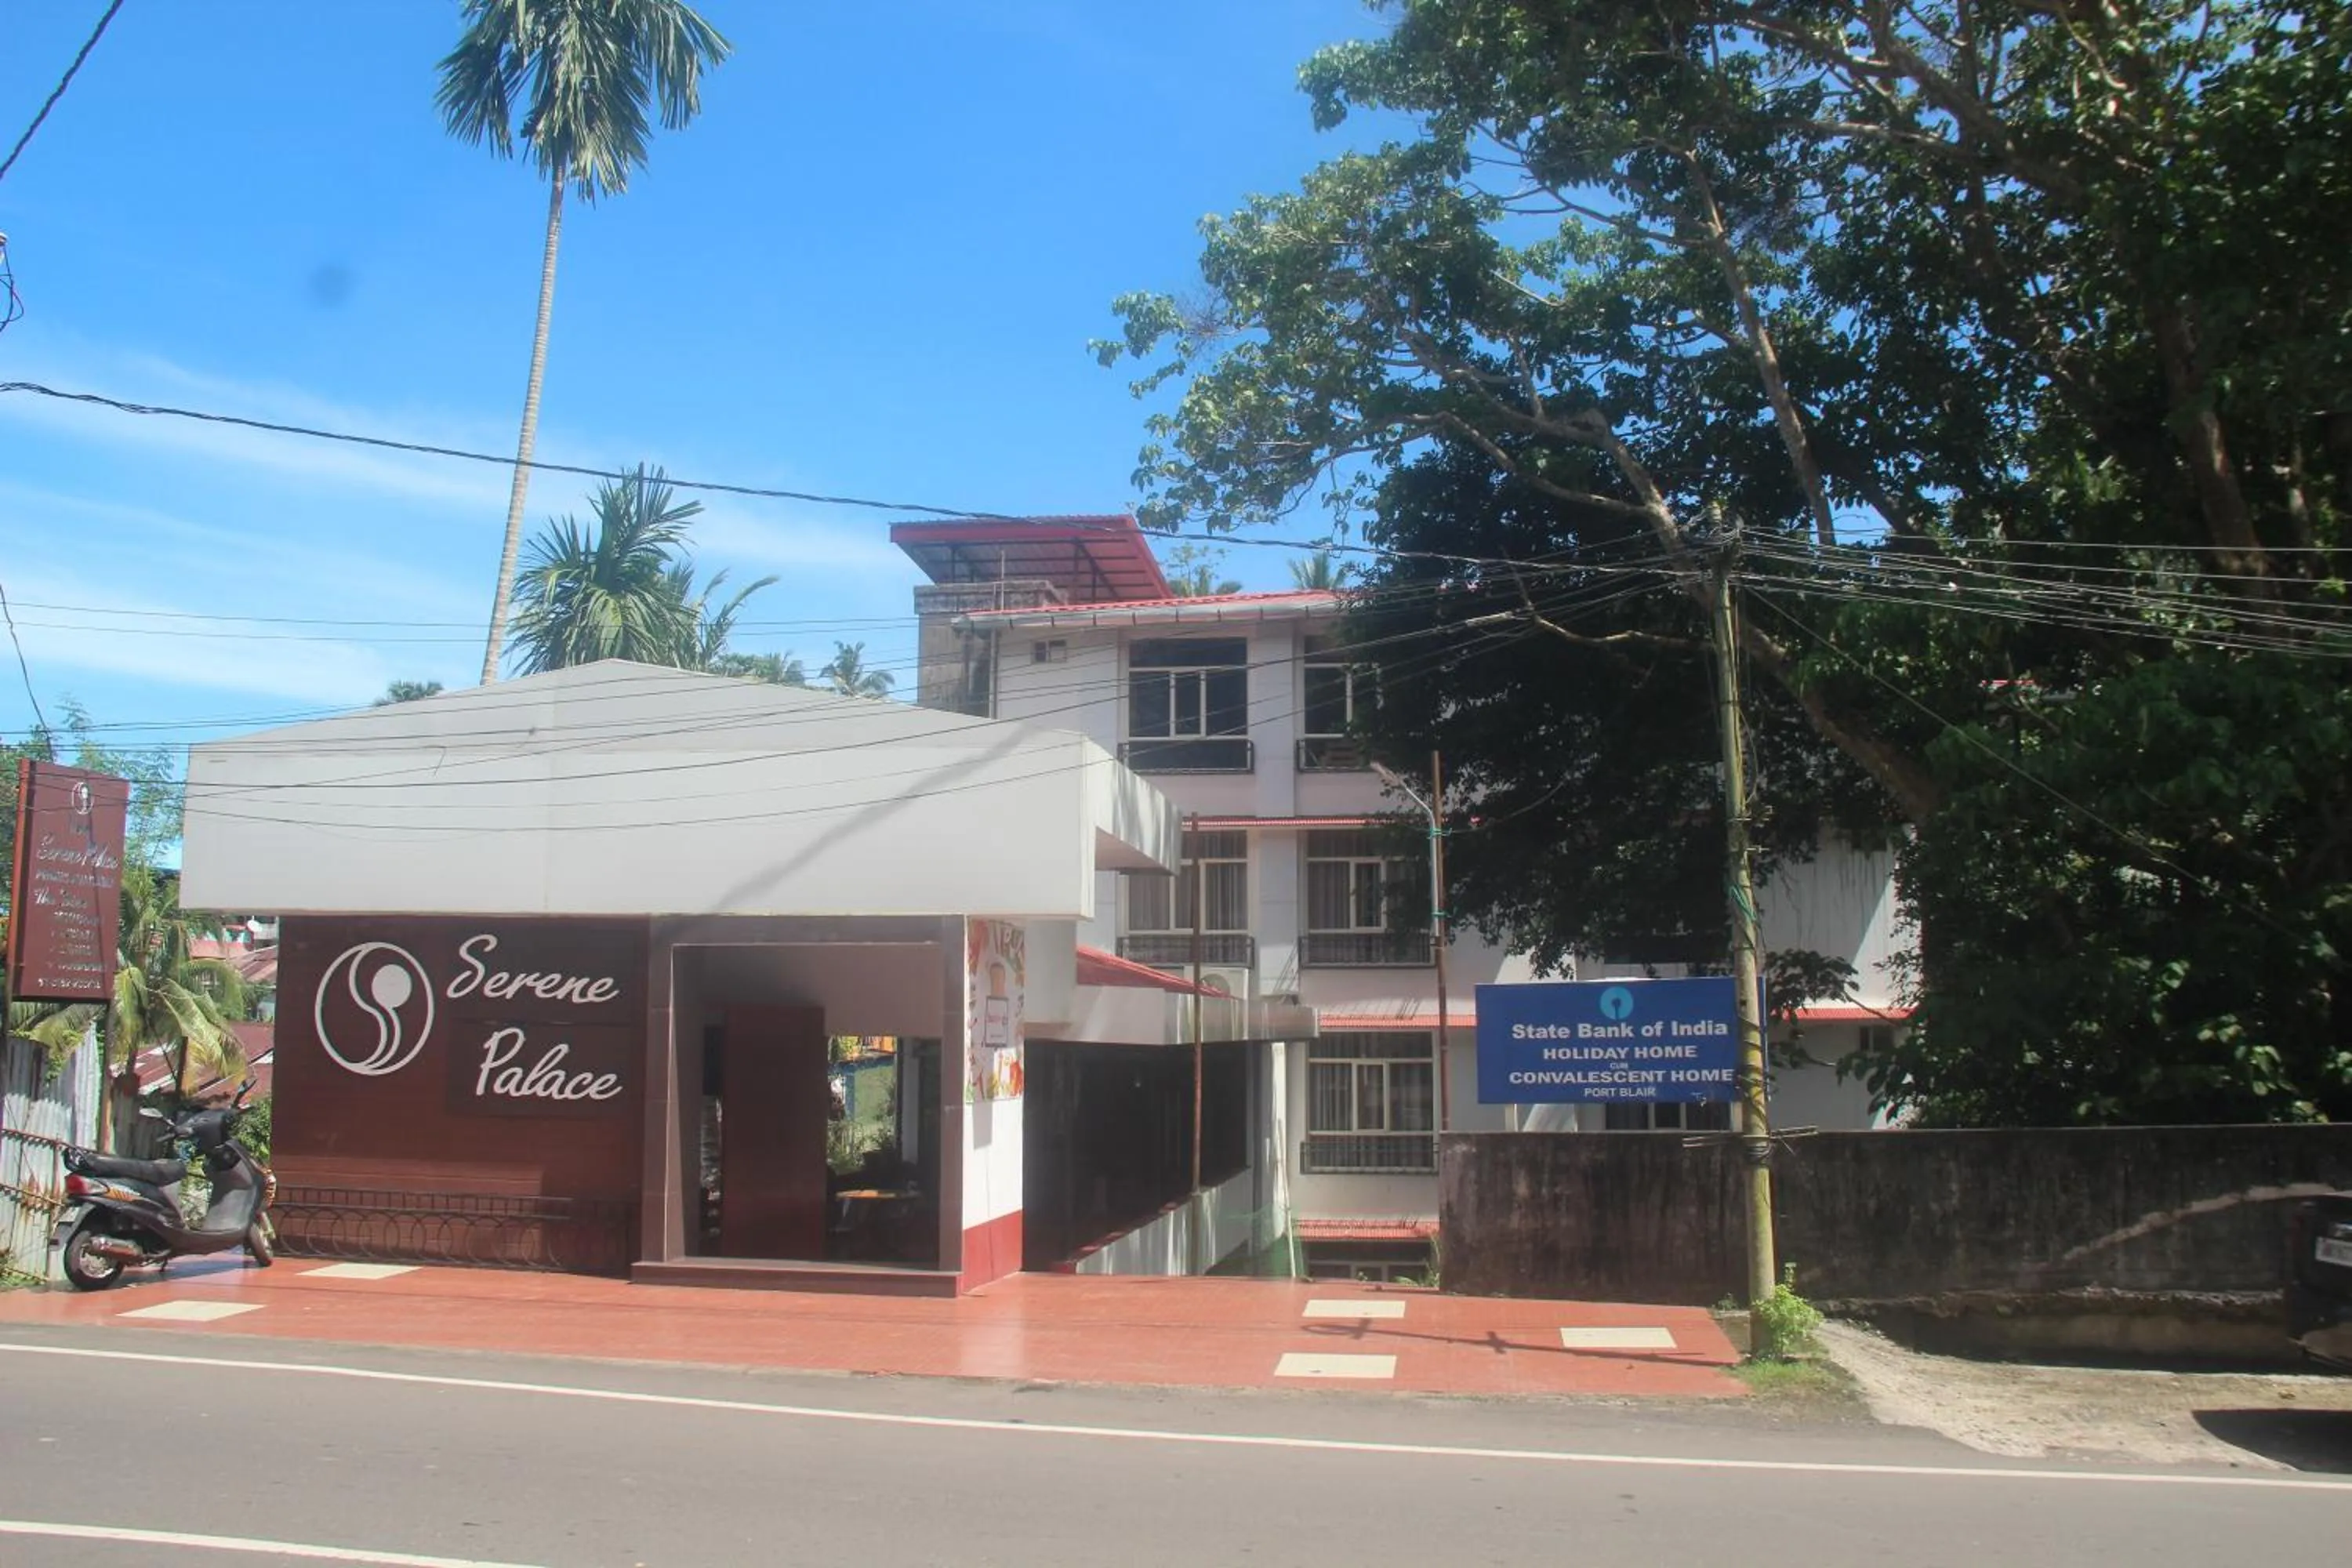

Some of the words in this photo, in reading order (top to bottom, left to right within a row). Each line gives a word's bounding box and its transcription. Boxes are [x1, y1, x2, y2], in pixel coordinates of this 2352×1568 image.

[447, 934, 619, 1004] Serene
[1512, 1023, 1570, 1040] State
[1577, 1022, 1635, 1039] Bank
[1641, 1021, 1664, 1037] of
[1671, 1020, 1729, 1036] India
[1544, 1047, 1629, 1059] HOLIDAY
[1635, 1045, 1698, 1058] HOME
[476, 1028, 622, 1100] Palace
[1509, 1070, 1667, 1083] CONVALESCENT
[1671, 1069, 1735, 1082] HOME
[1584, 1087, 1617, 1098] PORT
[1619, 1086, 1657, 1098] BLAIR
